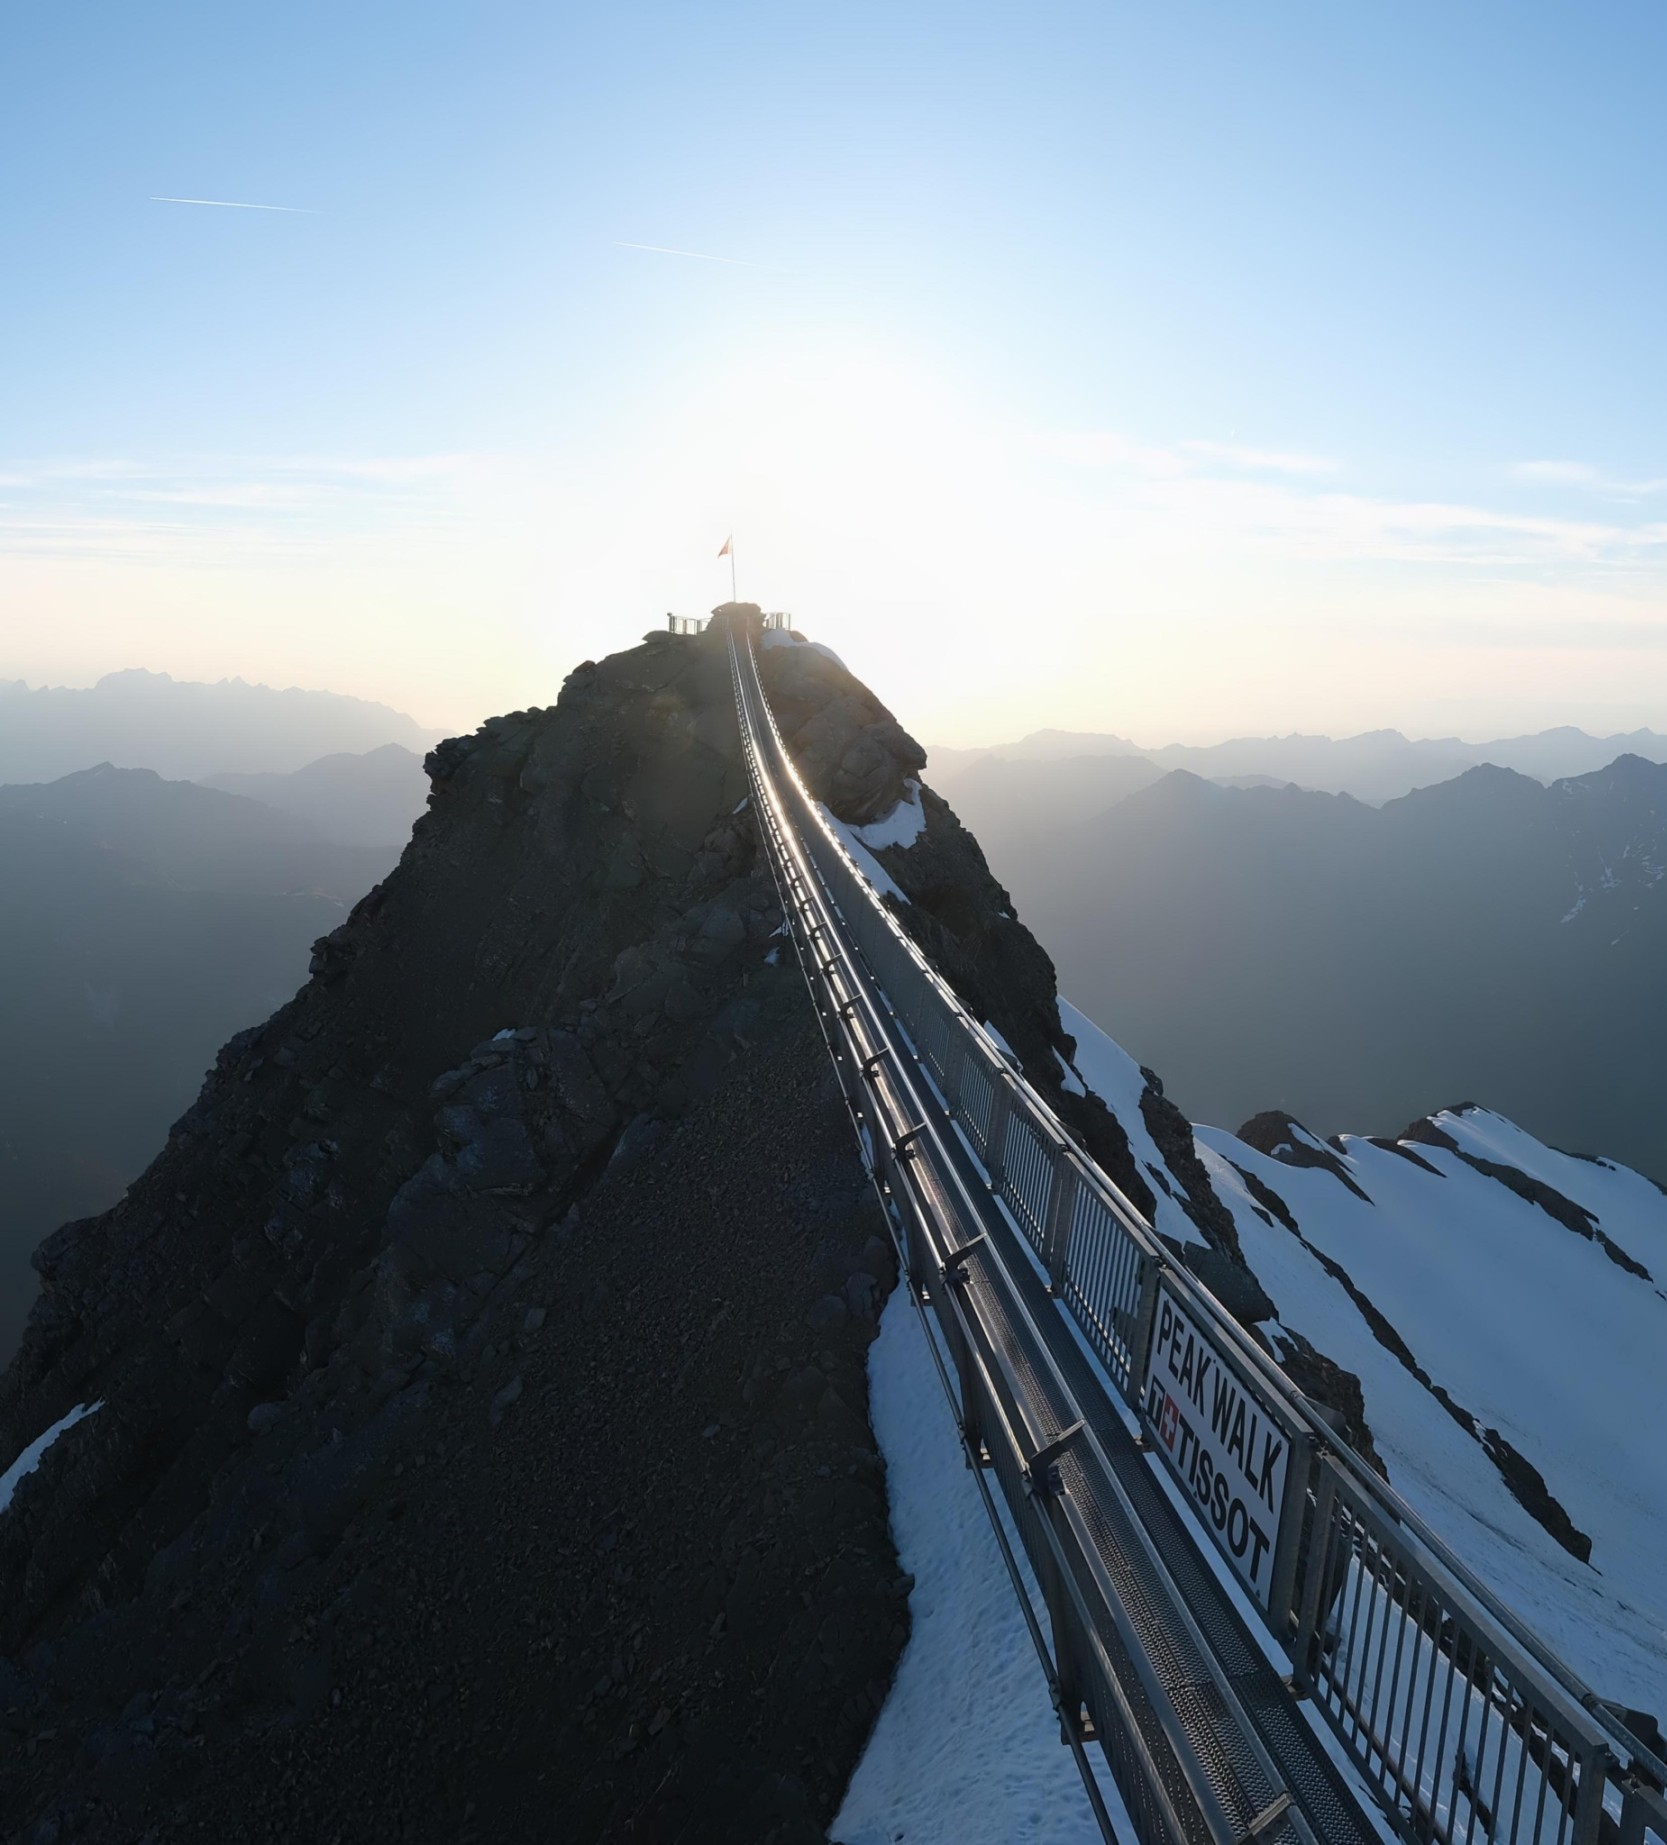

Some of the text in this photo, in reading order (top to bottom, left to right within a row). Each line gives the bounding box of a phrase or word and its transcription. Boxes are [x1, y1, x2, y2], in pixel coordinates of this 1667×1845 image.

[1157, 1300, 1282, 1515] PEAK WALK
[1178, 1413, 1271, 1584] TISSOT
